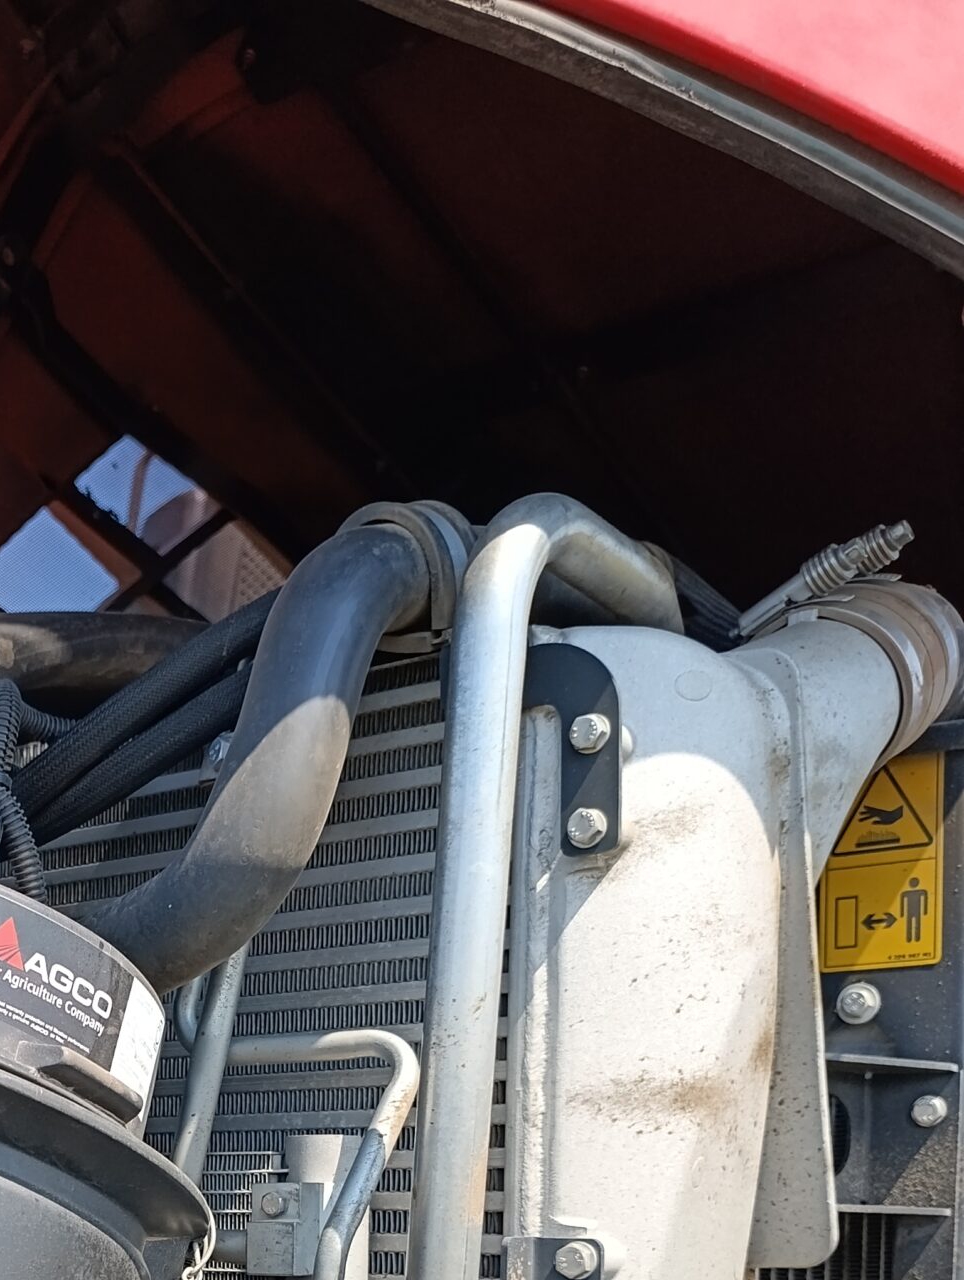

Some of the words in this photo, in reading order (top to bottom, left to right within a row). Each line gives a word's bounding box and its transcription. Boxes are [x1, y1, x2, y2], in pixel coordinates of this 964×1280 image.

[3, 970, 63, 1008] Agriculture
[64, 1000, 105, 1037] Company
[24, 952, 113, 1019] AGCO
